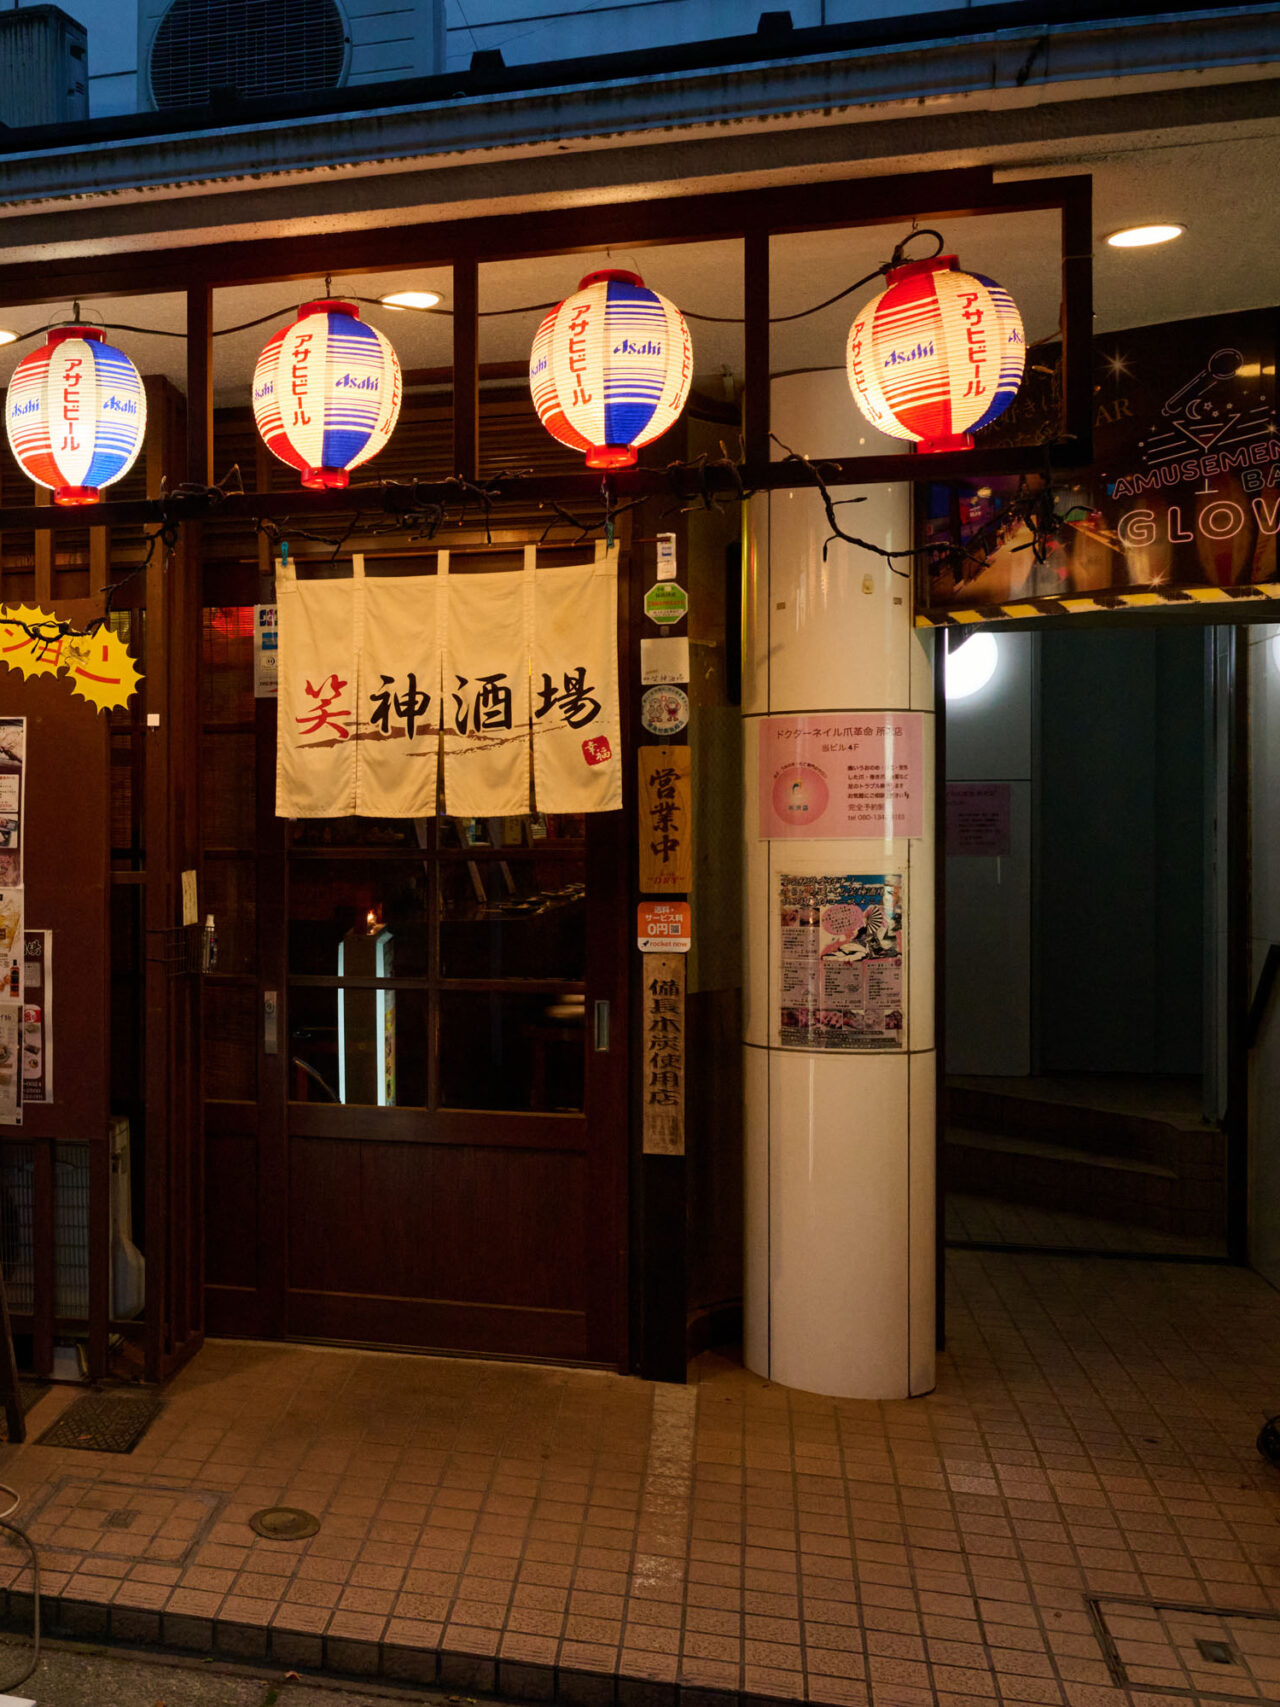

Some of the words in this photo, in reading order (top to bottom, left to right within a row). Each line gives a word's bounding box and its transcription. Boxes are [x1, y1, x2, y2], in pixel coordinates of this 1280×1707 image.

[292, 333, 313, 426] アサヒビール
[568, 304, 593, 407] アサヒビール
[613, 339, 661, 356] Asahi
[884, 340, 935, 367] Asahi
[956, 292, 987, 398] アサヒビール
[61, 358, 83, 451] アサヒビール
[103, 395, 138, 415] Asahi
[335, 373, 379, 392] Asahi
[295, 667, 602, 741] 笑神酒場
[777, 727, 872, 740] ドクターネイル爪革命
[649, 768, 681, 863] 営業中
[647, 923, 668, 936] 0円
[649, 979, 681, 1106] 備長木炭使用店
